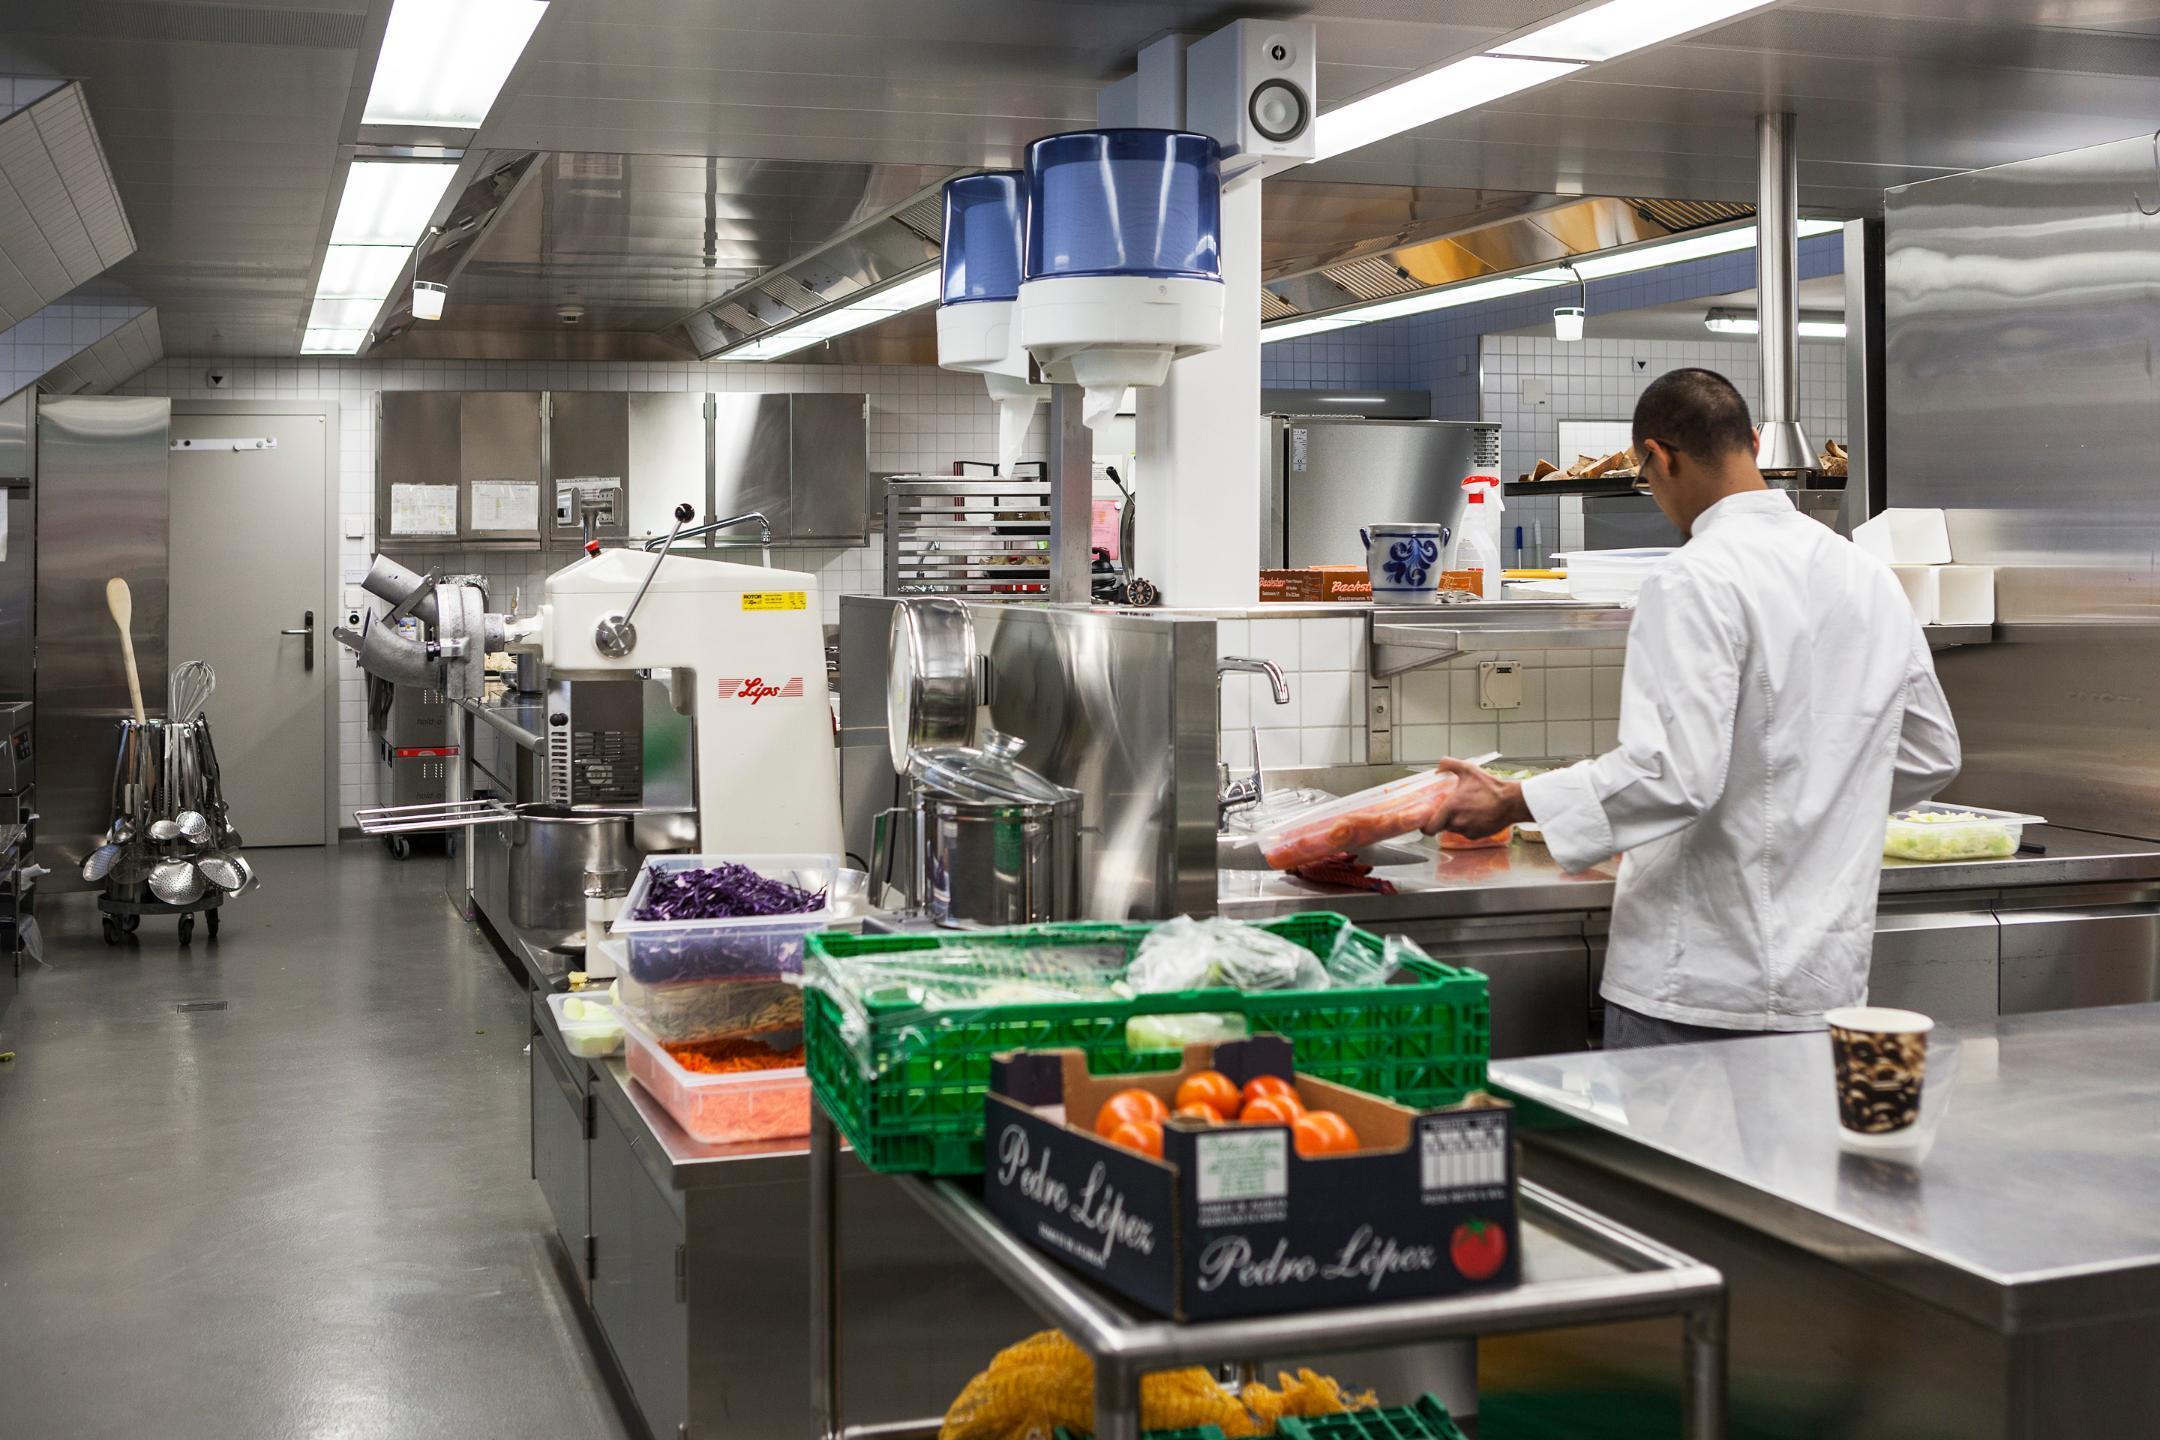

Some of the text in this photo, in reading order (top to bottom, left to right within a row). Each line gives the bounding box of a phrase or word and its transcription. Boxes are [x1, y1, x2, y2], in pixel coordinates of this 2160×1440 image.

[737, 677, 780, 705] Lips
[998, 1123, 1069, 1213] Pedro
[1069, 1160, 1156, 1259] López
[1197, 1223, 1436, 1292] Pedro López
